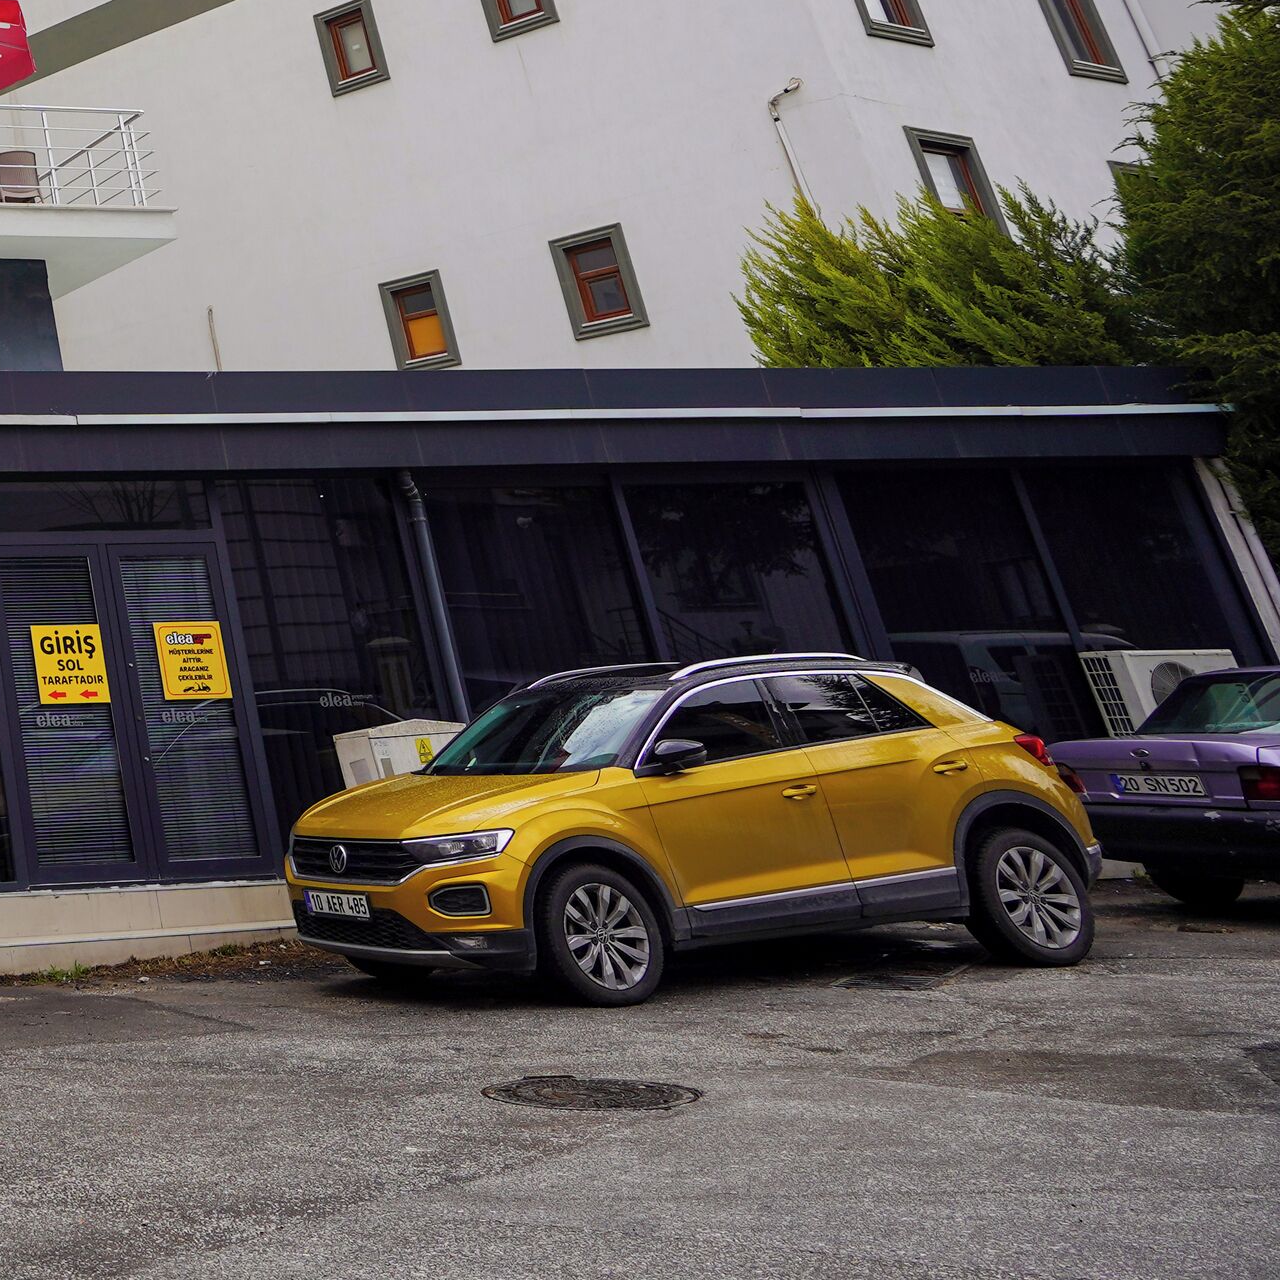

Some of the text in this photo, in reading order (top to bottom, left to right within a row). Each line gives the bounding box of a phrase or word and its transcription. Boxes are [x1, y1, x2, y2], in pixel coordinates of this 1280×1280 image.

[40, 630, 96, 659] GİRİŞ
[165, 631, 194, 645] elea
[57, 659, 85, 672] SOL
[42, 675, 104, 686] TARAFTADIR
[178, 673, 214, 682] ÇEKİLEBİLİR
[320, 691, 352, 708] elea
[36, 711, 72, 728] elea
[162, 708, 195, 724] elea
[1120, 776, 1140, 792] 20
[311, 893, 367, 915] 10 AER 485
